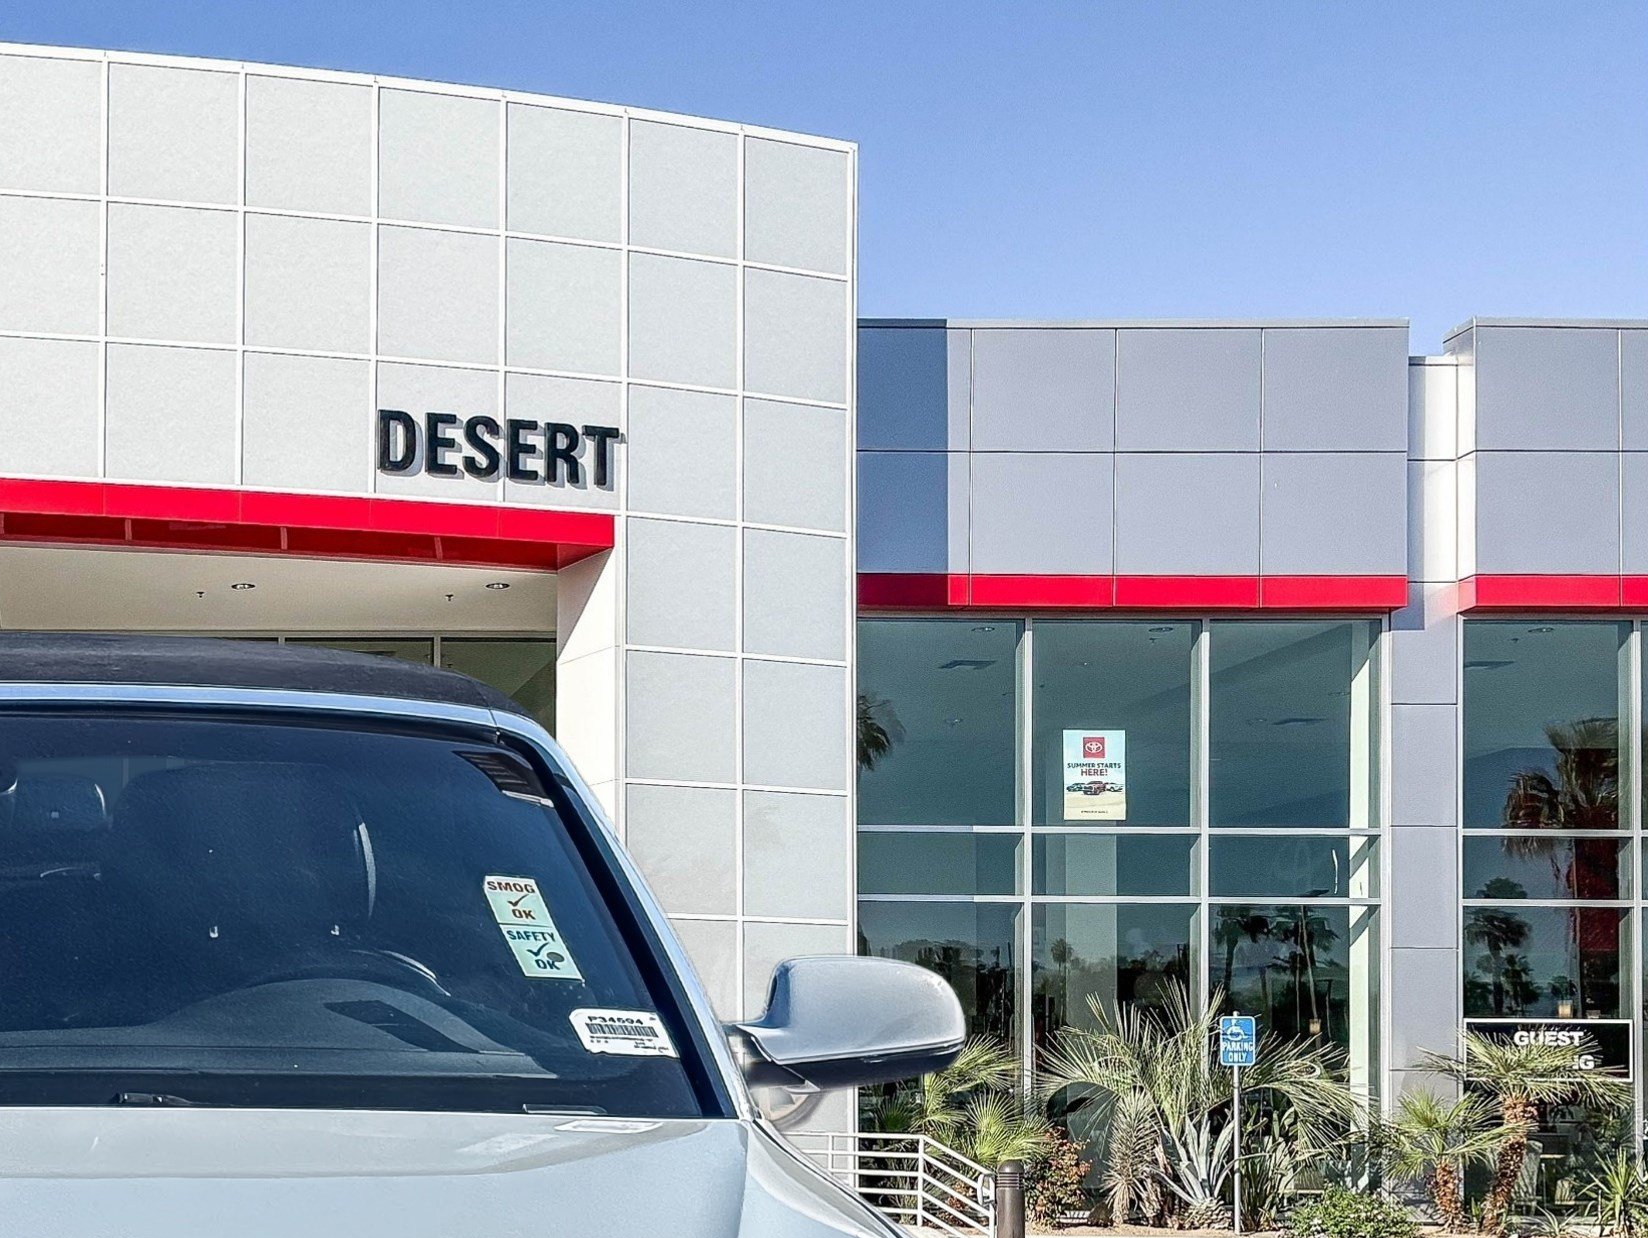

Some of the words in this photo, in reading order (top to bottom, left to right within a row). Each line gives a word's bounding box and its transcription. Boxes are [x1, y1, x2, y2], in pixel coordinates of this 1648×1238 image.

[376, 409, 620, 486] DESERT
[1080, 768, 1108, 777] HERE!
[486, 880, 536, 894] SMOG
[511, 908, 536, 920] OK
[506, 930, 556, 942] SAFETY
[535, 958, 561, 971] OK
[1222, 1041, 1253, 1051] PARKING
[1228, 1052, 1248, 1062] ONLY
